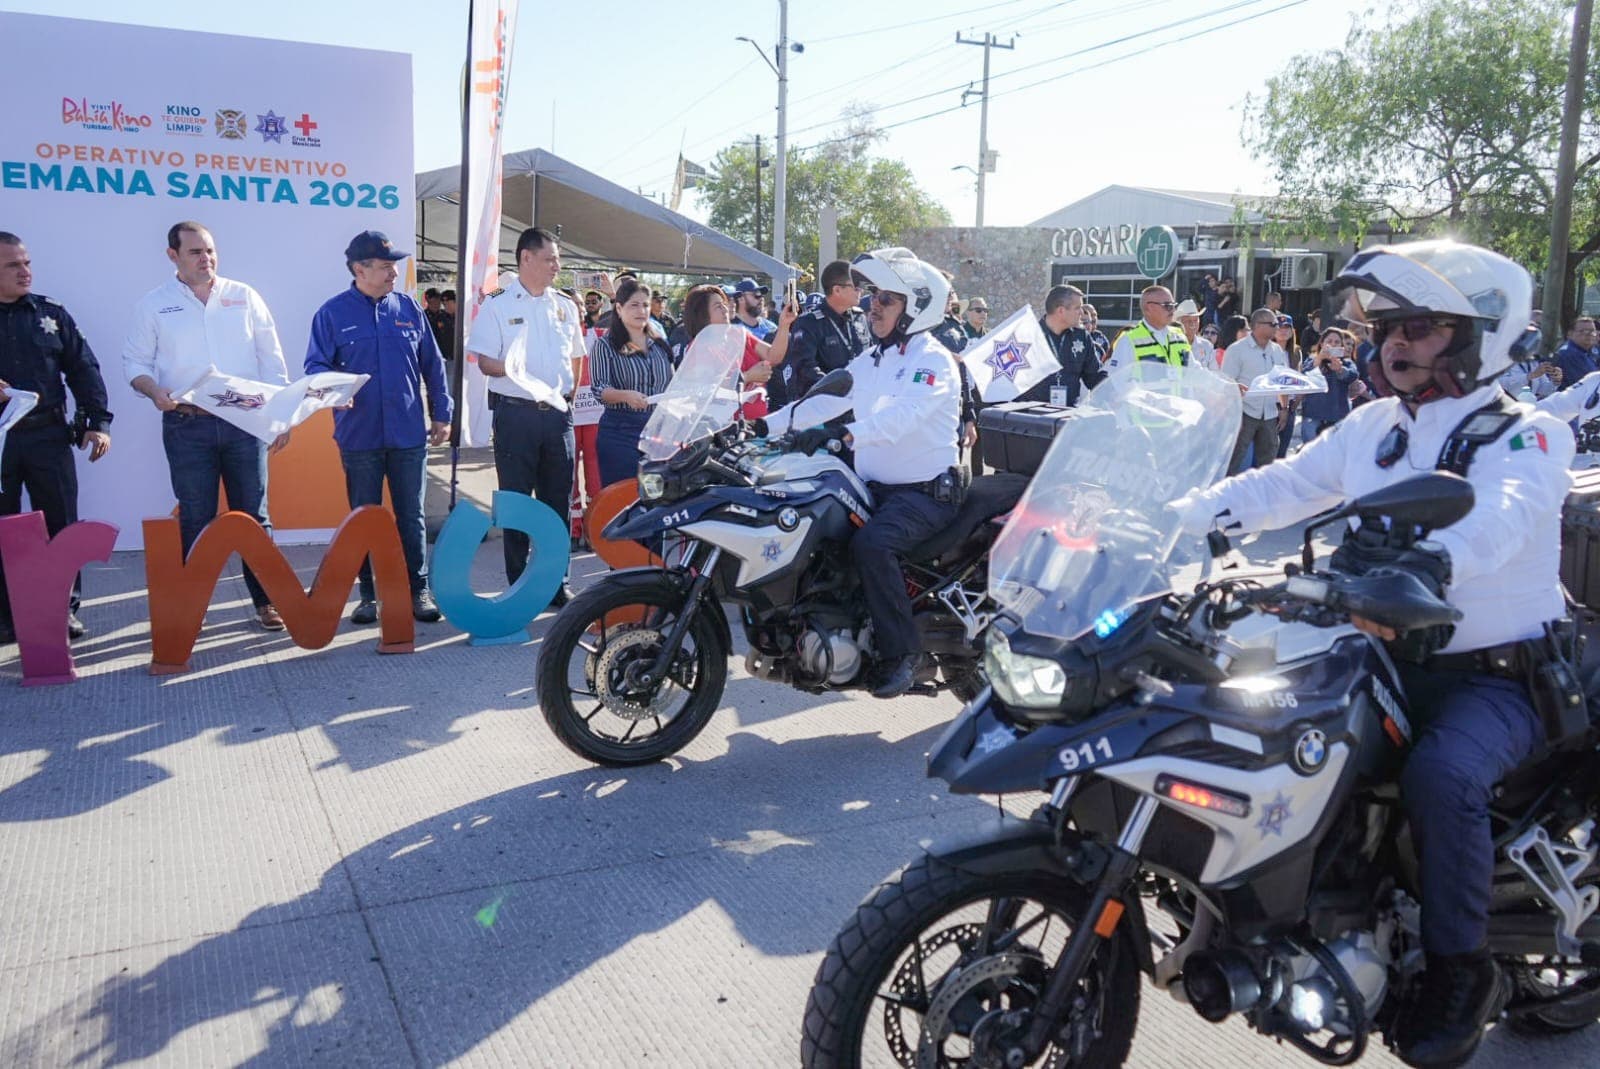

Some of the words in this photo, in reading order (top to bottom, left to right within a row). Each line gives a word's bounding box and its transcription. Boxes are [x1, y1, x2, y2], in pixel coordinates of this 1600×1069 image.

[112, 101, 152, 132] Kino
[166, 105, 201, 117] KINO
[82, 123, 112, 131] TURISMO
[36, 143, 184, 167] OPERATIVO
[195, 153, 347, 178] PREVENTIVO
[2, 161, 155, 196] EMANA
[167, 171, 299, 205] SANTA
[309, 180, 400, 210] 2026
[662, 509, 690, 526] 911
[1059, 736, 1114, 770] 911
